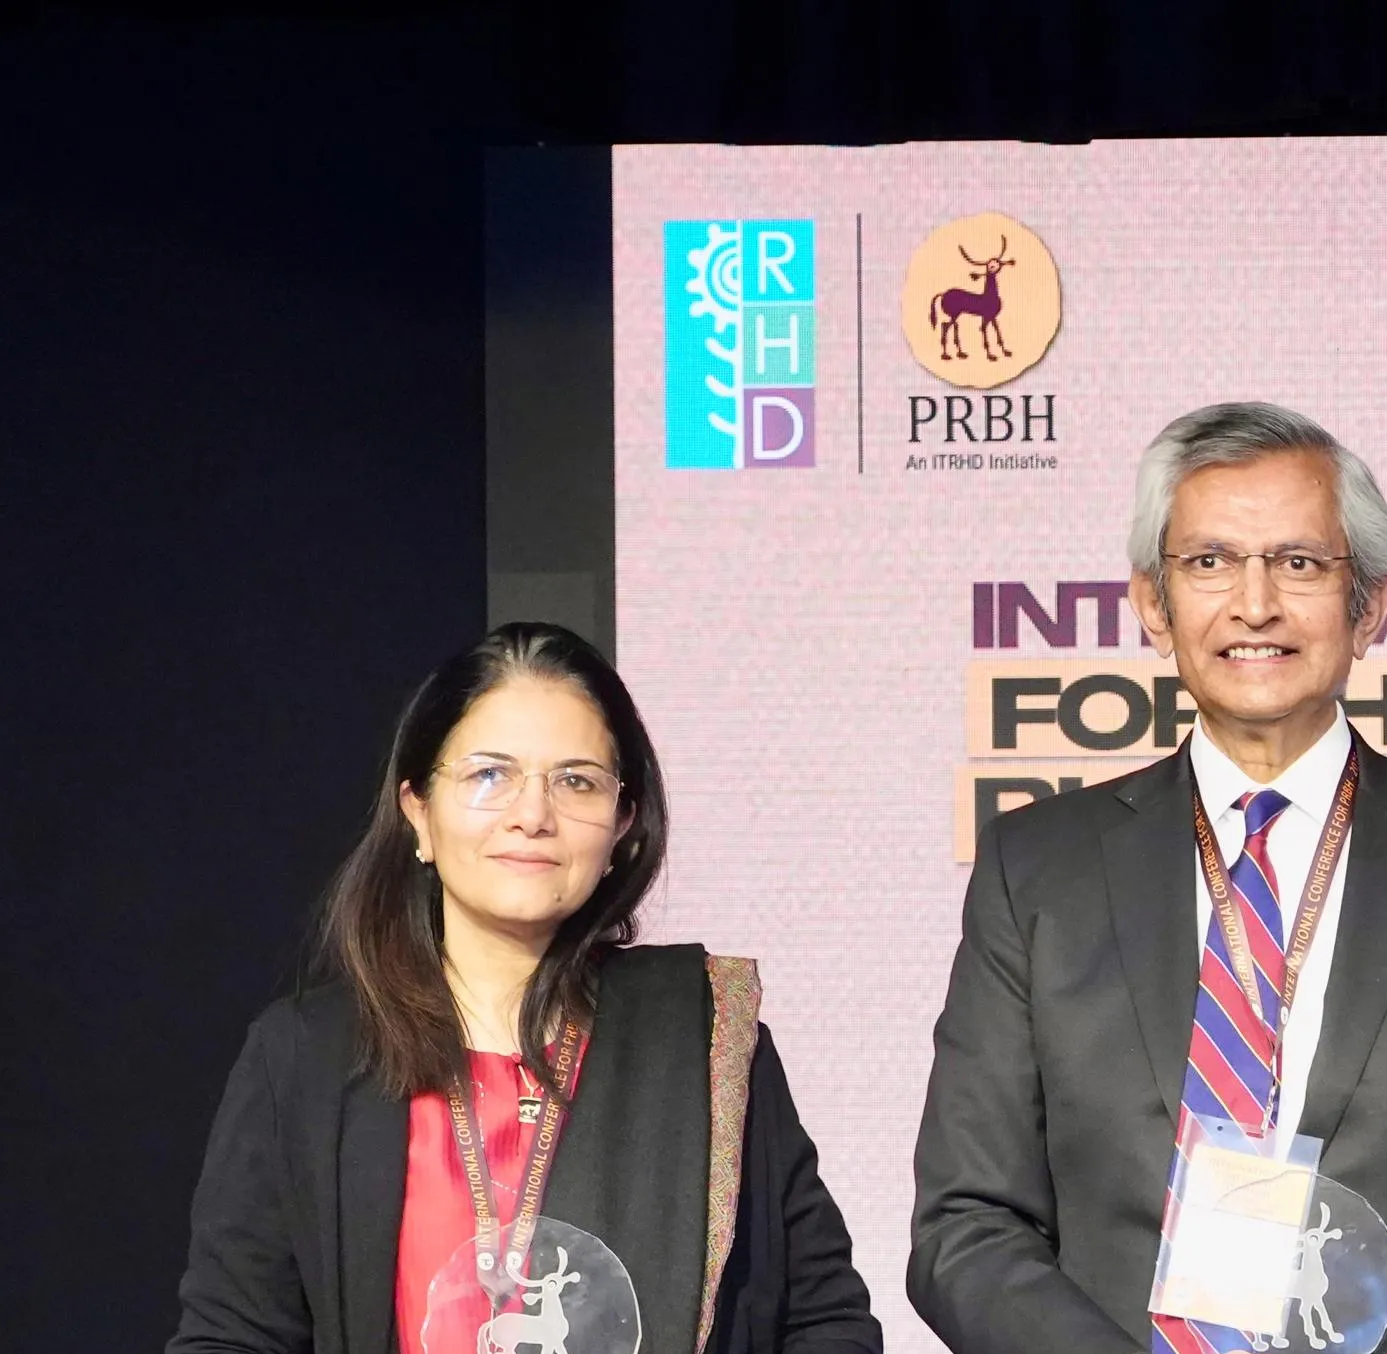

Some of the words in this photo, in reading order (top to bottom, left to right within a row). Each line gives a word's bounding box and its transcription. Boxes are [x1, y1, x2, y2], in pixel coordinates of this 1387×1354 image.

[906, 454, 927, 470] An
[933, 454, 984, 470] ITRHD
[989, 453, 1058, 470] Initiative
[907, 395, 1057, 443] PRBH
[1282, 905, 1317, 1005] INTERNATIONAL
[1308, 826, 1341, 903] CONFERENCE
[1332, 804, 1349, 829] FOR
[466, 1147, 492, 1248] INTERNATIONAL
[513, 1153, 548, 1249] INTERNATIONAL
[556, 1047, 572, 1073] FOR
